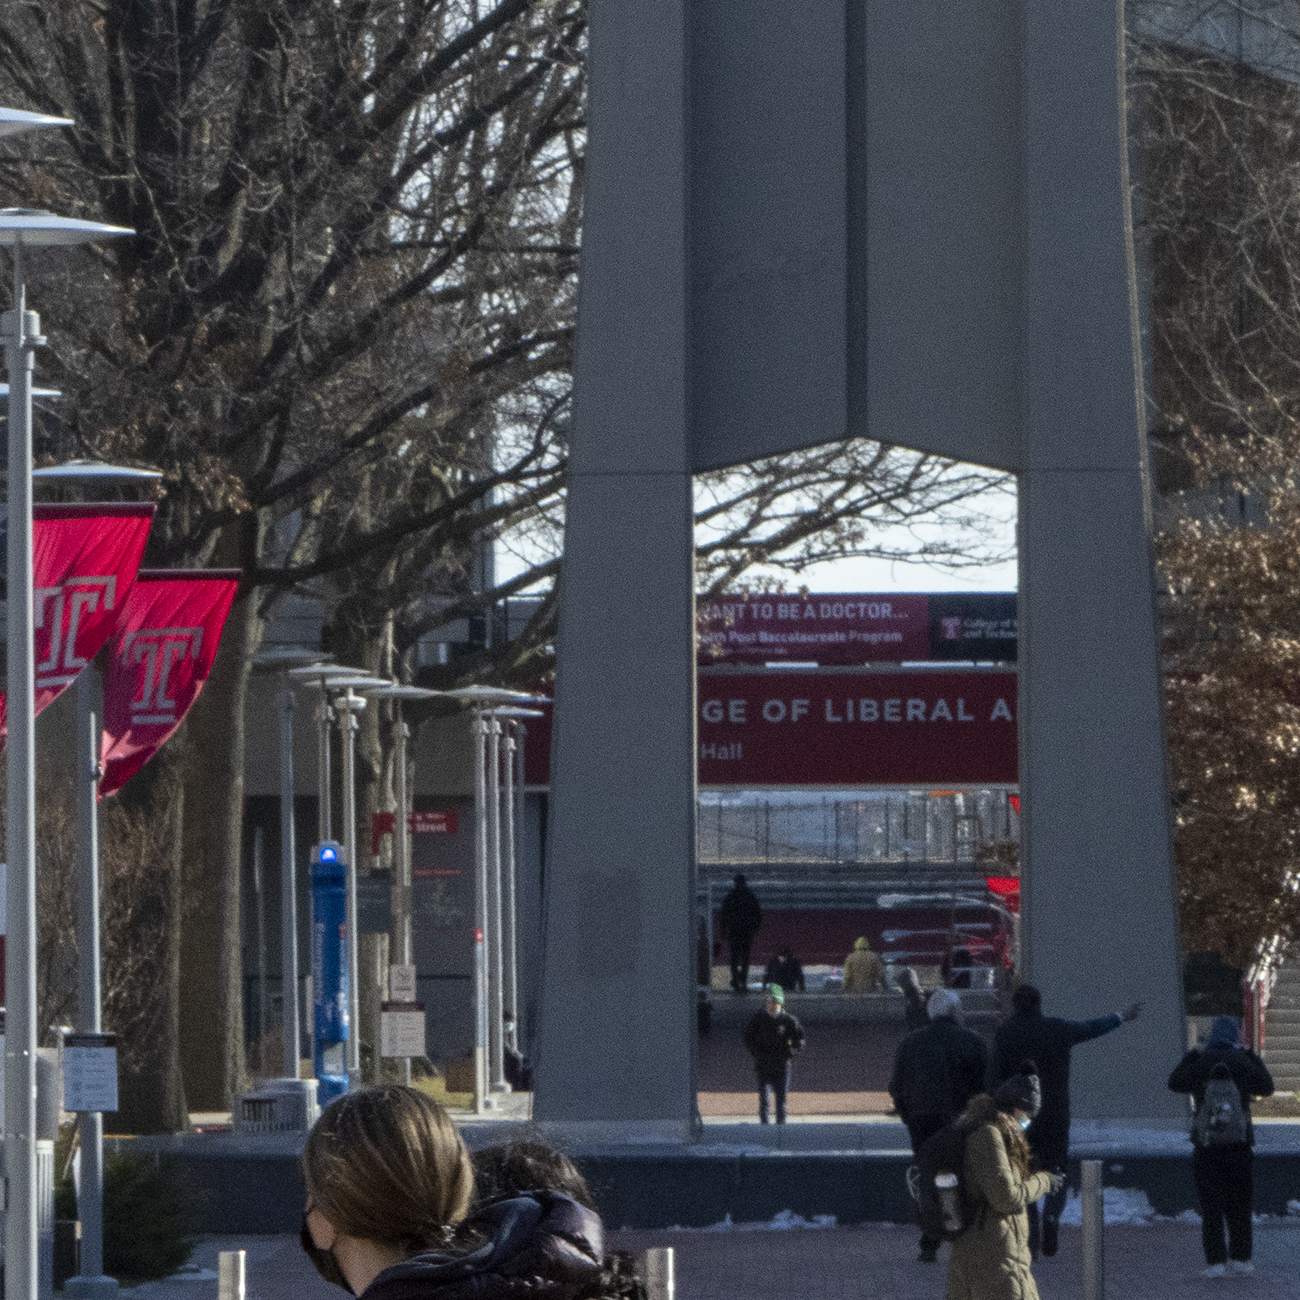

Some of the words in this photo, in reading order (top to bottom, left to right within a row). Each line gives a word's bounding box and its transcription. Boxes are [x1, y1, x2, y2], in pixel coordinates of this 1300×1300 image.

[751, 603, 774, 619] TO
[777, 603, 800, 619] BE
[803, 603, 817, 619] A
[849, 630, 903, 645] Program
[762, 698, 810, 723] OF
[825, 698, 974, 723] LIBERAL
[701, 742, 743, 761] Hall
